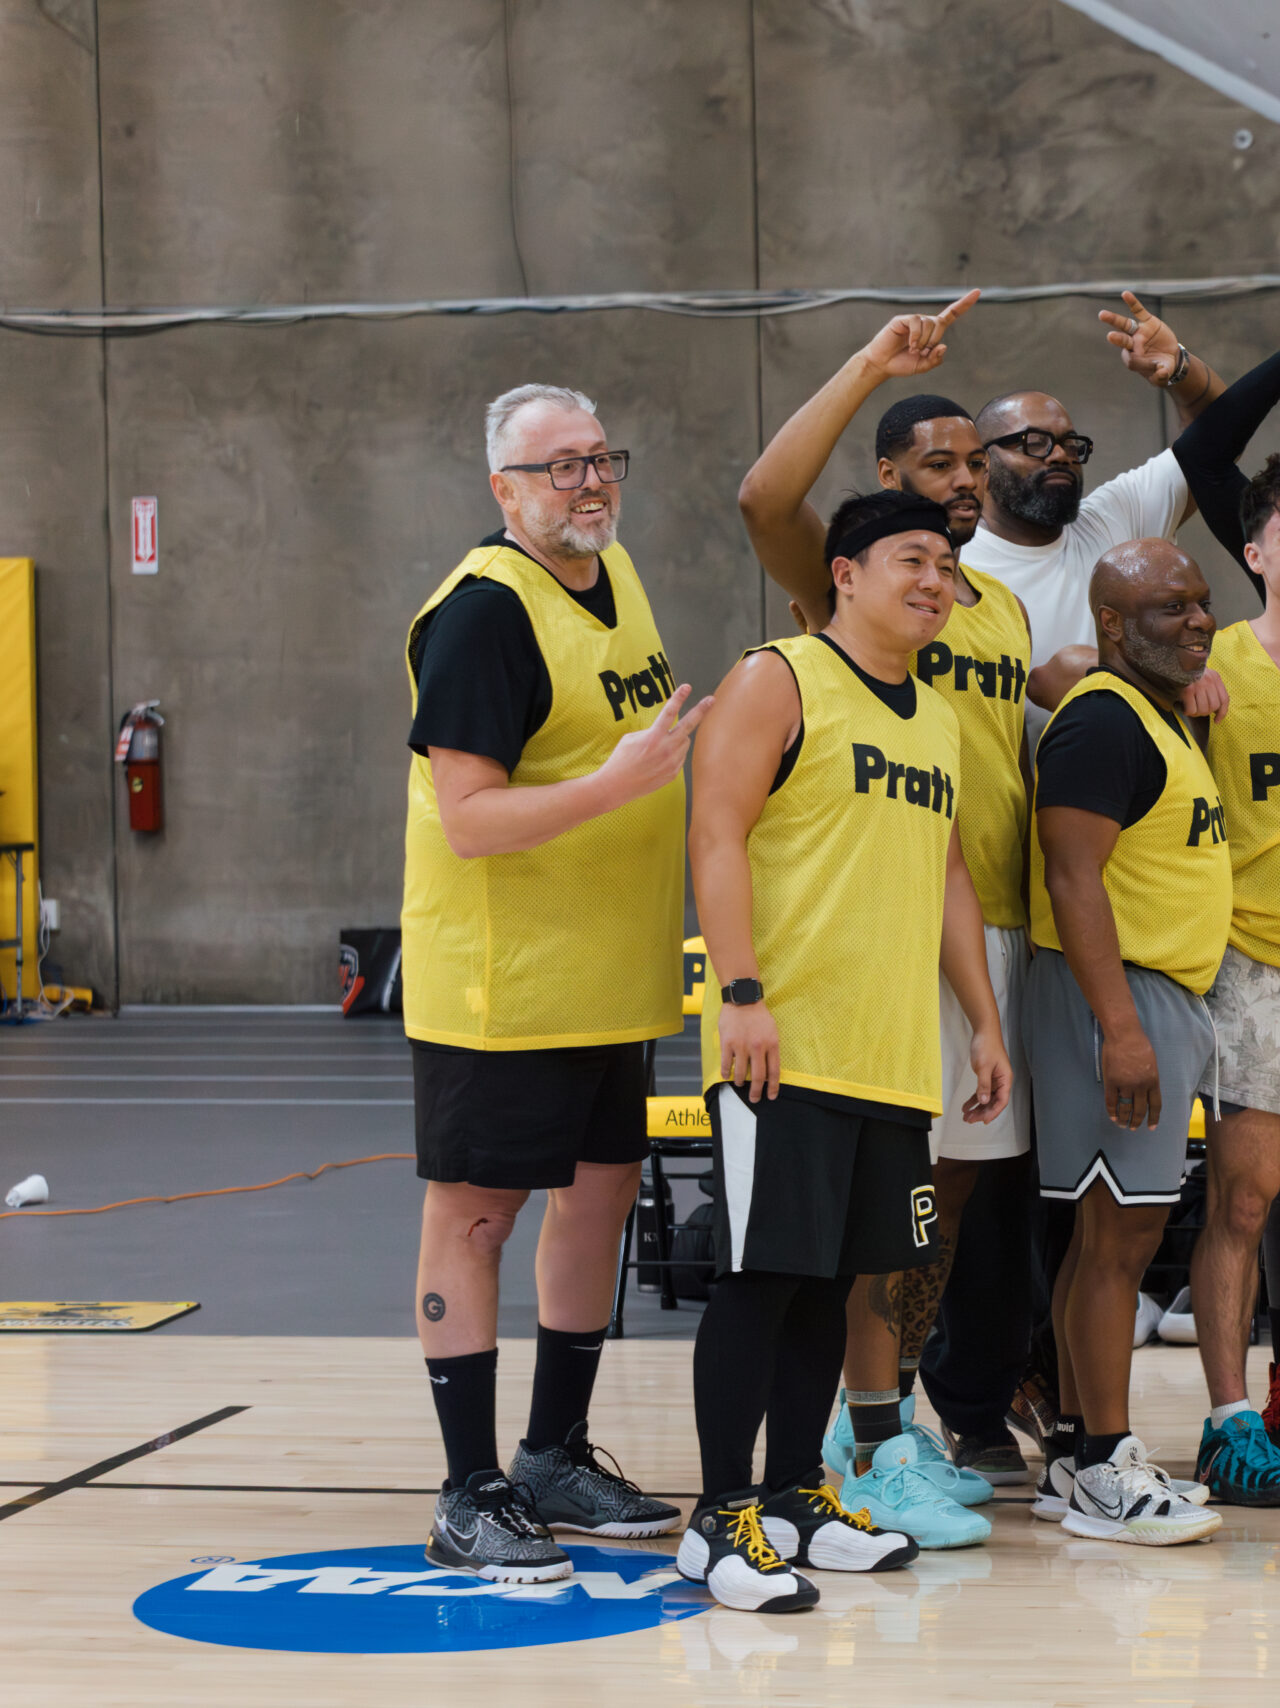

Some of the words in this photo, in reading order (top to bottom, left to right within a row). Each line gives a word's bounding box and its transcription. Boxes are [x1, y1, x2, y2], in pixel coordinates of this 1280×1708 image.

[917, 640, 1026, 704] Pratt
[852, 742, 954, 820] Pratt
[665, 1108, 711, 1127] Athle
[911, 1184, 938, 1248] P
[184, 1564, 686, 1600] NCAA
